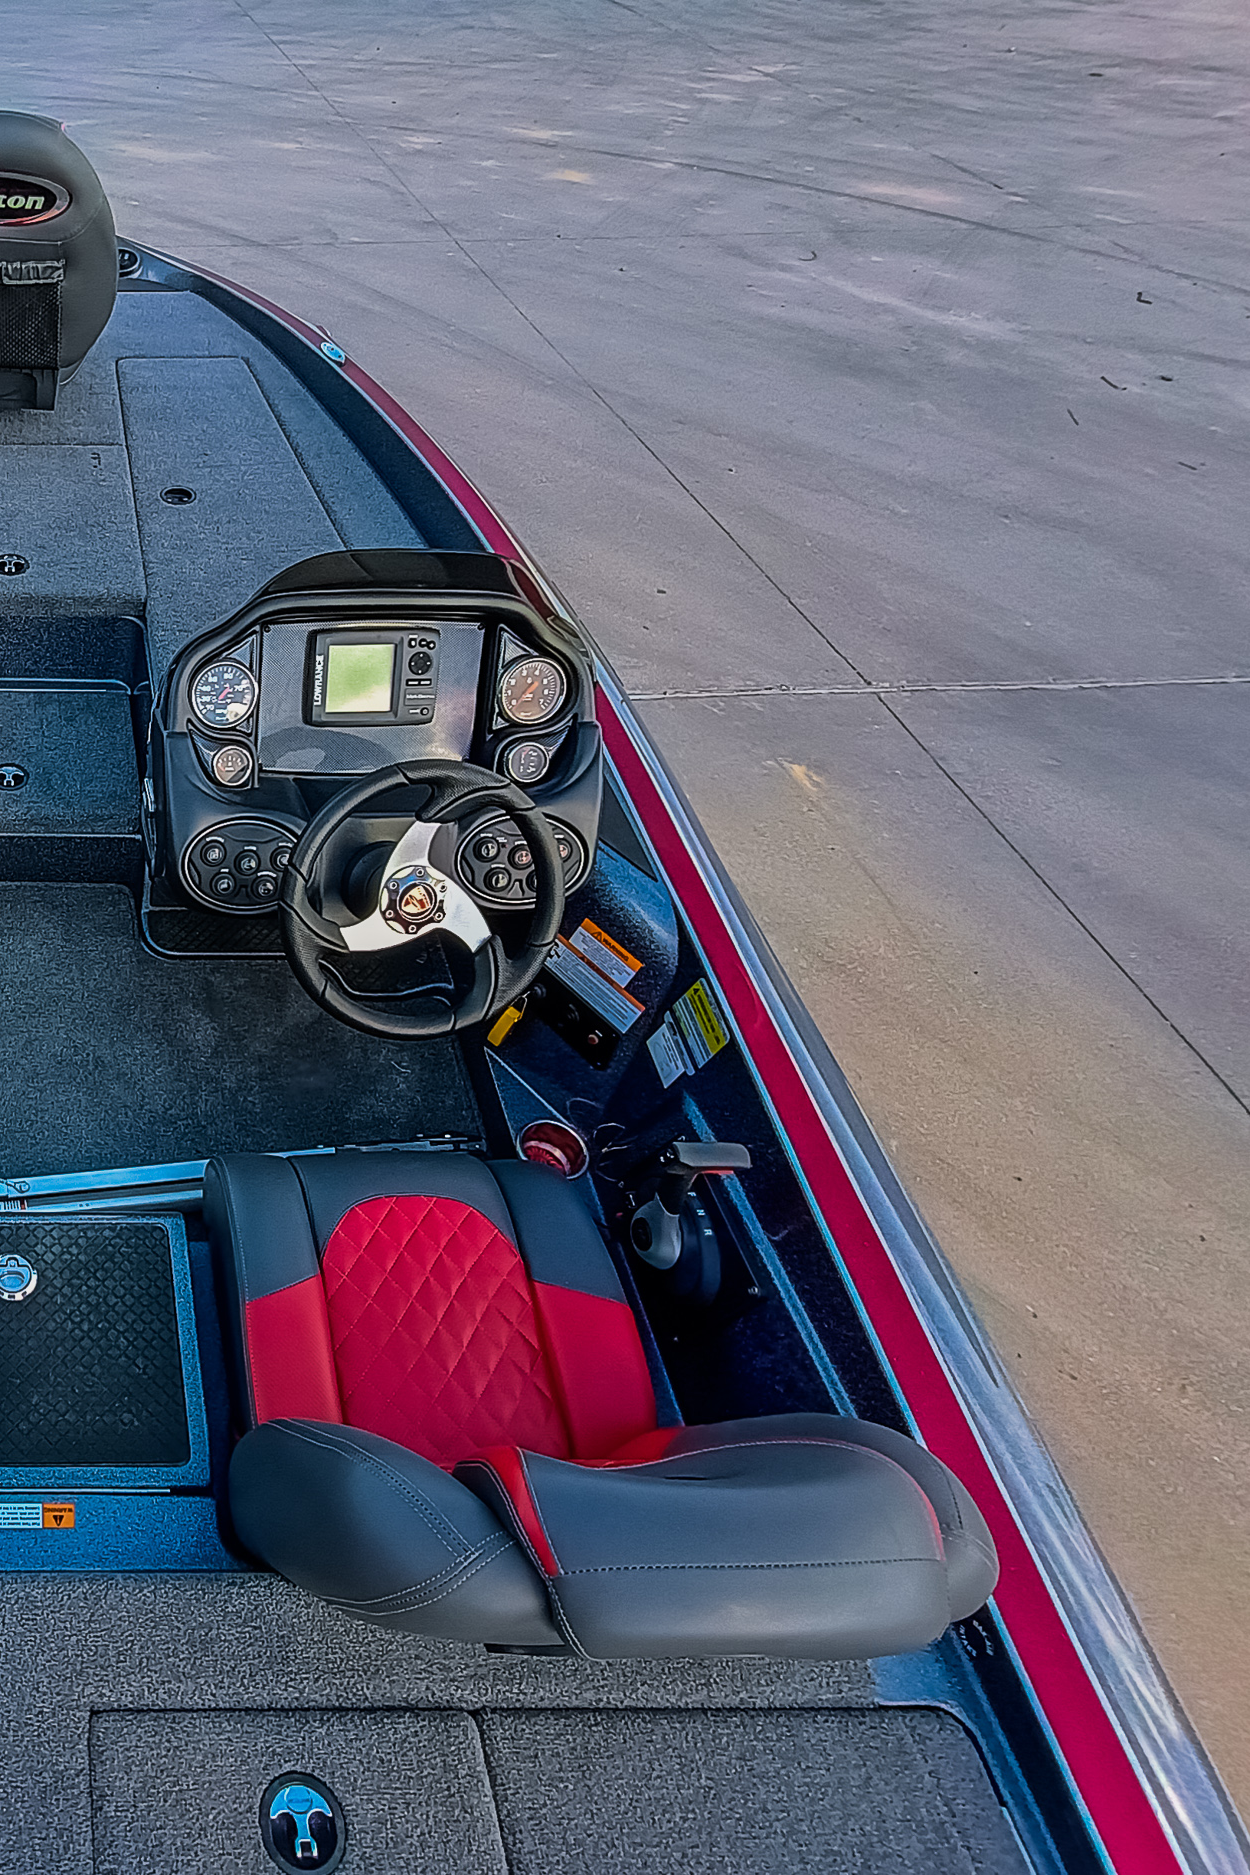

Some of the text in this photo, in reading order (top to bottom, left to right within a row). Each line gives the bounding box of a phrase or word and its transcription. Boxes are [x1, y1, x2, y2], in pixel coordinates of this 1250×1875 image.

[313, 655, 324, 706] LOWRANCE
[602, 938, 629, 962] WARNING
[703, 1228, 713, 1236] R
